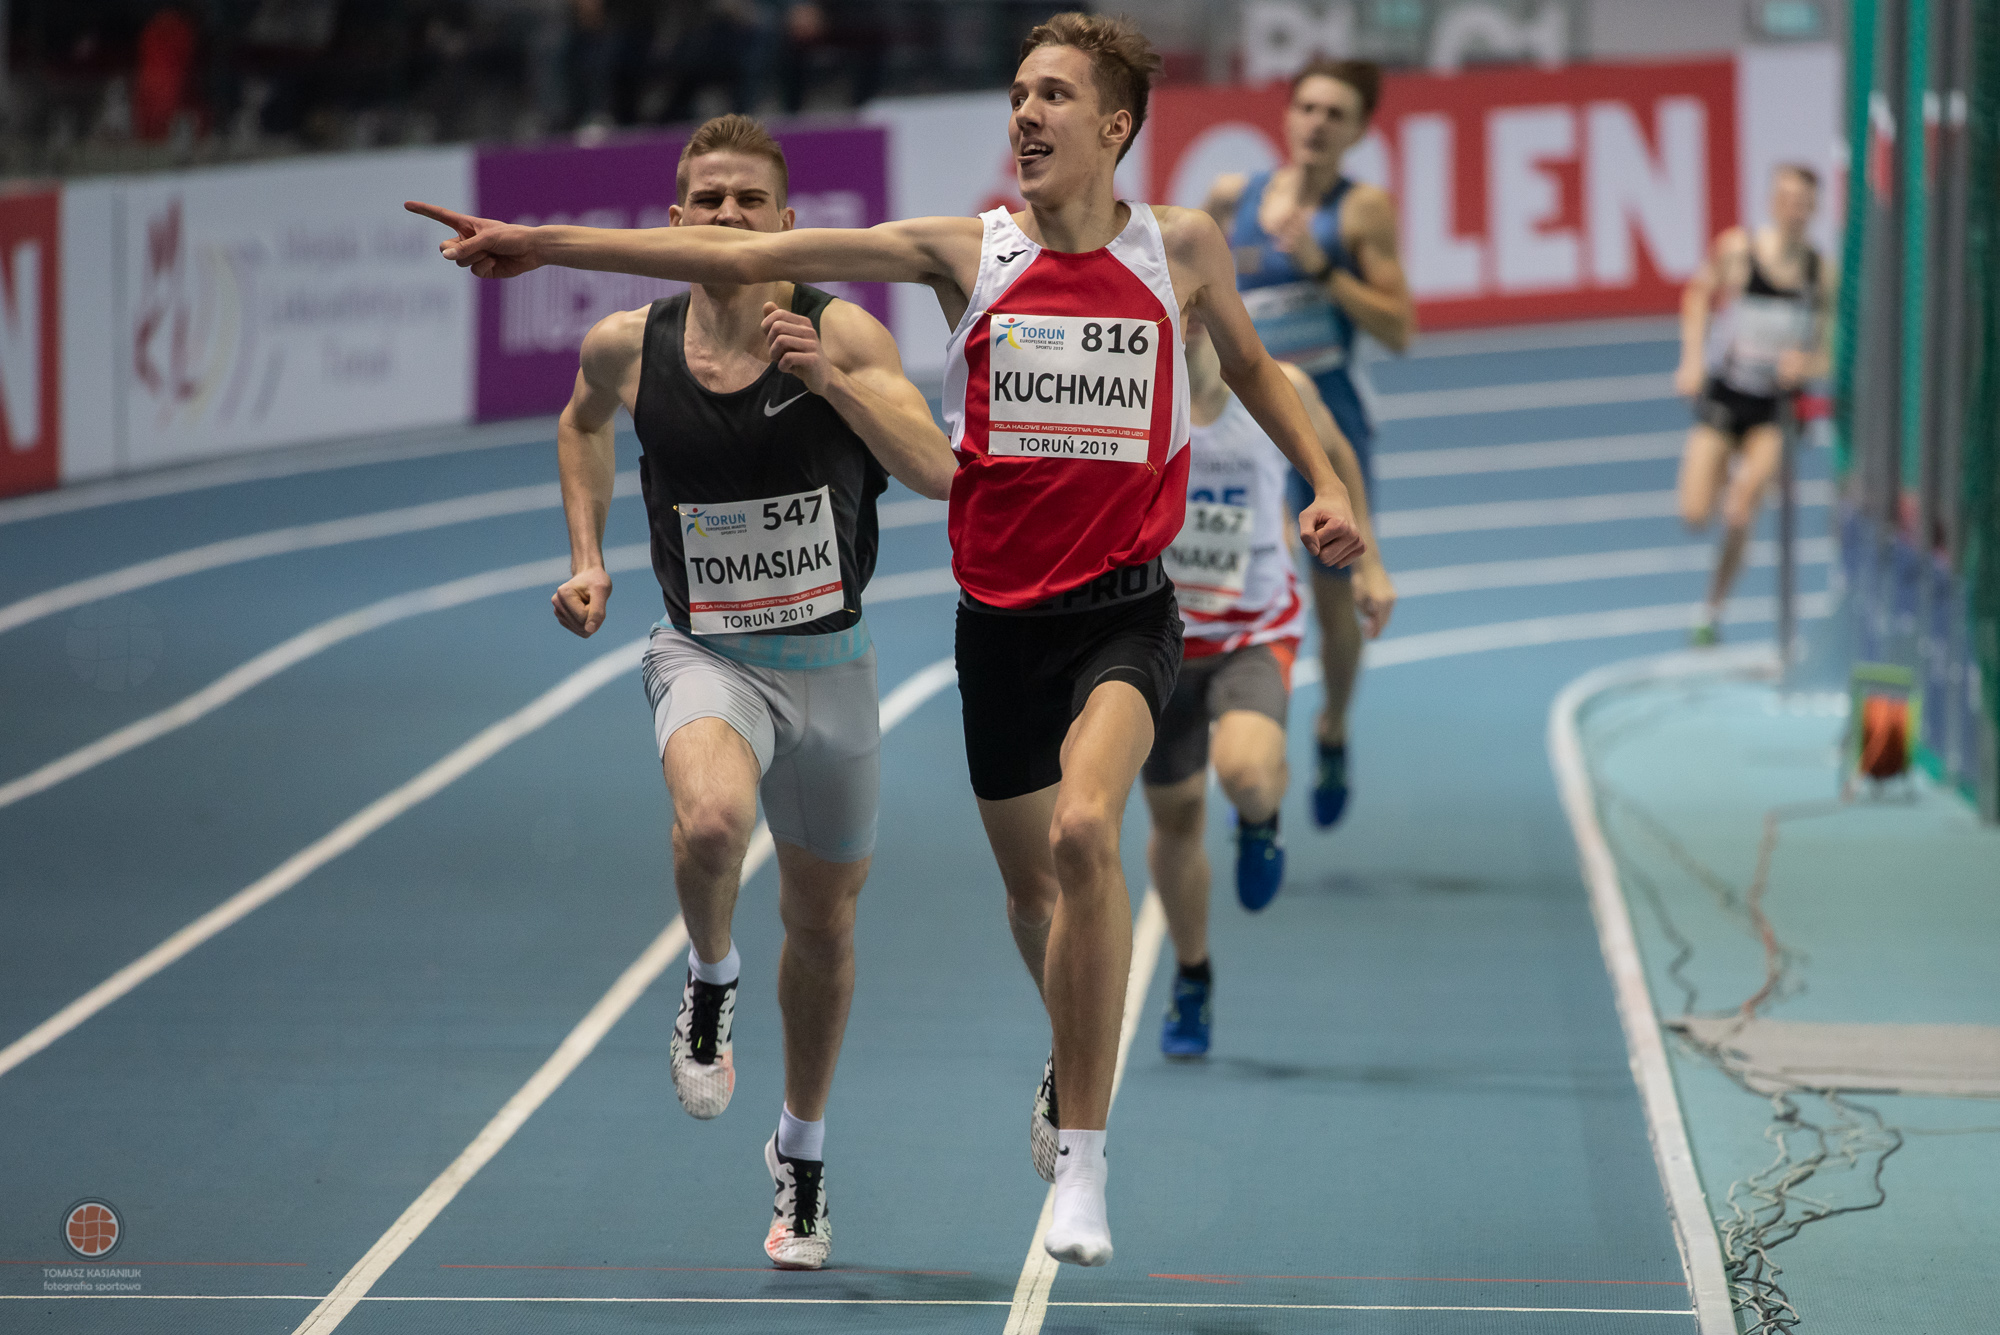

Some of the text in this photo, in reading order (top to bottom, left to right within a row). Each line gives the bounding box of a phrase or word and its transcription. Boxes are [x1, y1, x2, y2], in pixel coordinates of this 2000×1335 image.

[1165, 95, 1707, 300] LEN
[1020, 325, 1065, 340] TORUŃ
[1081, 322, 1149, 355] 816
[994, 370, 1148, 410] KUCHMAN
[1041, 425, 1092, 433] MISTRZOSTWA
[1092, 427, 1118, 435] POLSKI
[1019, 436, 1119, 456] TORUŃ 2019
[705, 510, 746, 526] TORUŃ
[763, 494, 822, 530] 547
[690, 540, 832, 584] TOMASIAK
[740, 598, 788, 608] MISTRZOSTWA
[788, 593, 810, 602] POLSKI
[722, 603, 814, 628] TORUŃ 2019
